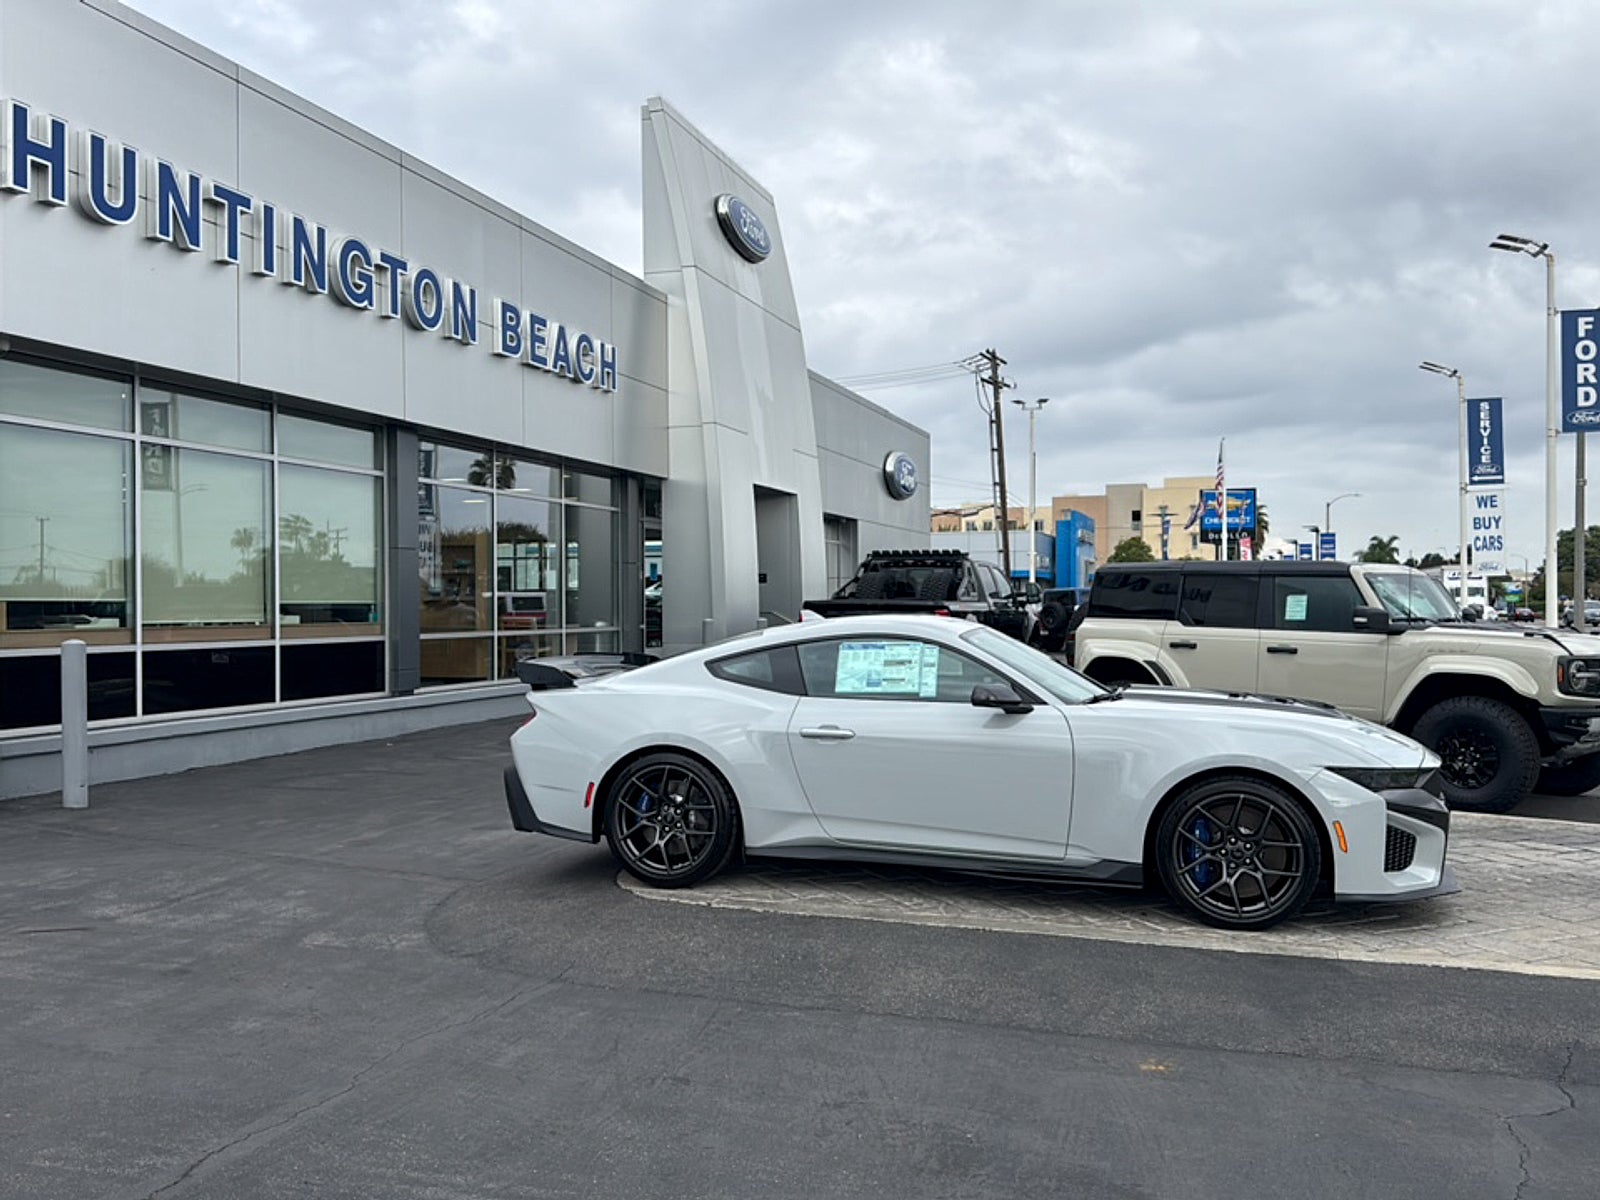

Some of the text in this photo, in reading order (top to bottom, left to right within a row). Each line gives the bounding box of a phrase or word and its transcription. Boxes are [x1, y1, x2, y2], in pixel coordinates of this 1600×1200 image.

[4, 100, 618, 391] HUNTINGTON BEACH
[1575, 316, 1598, 408] FORD
[1480, 401, 1491, 464] SERVICE
[1476, 494, 1498, 509] WE
[1204, 516, 1251, 525] CHEROLT
[1473, 515, 1502, 530] BUY
[1473, 535, 1503, 552] CARS
